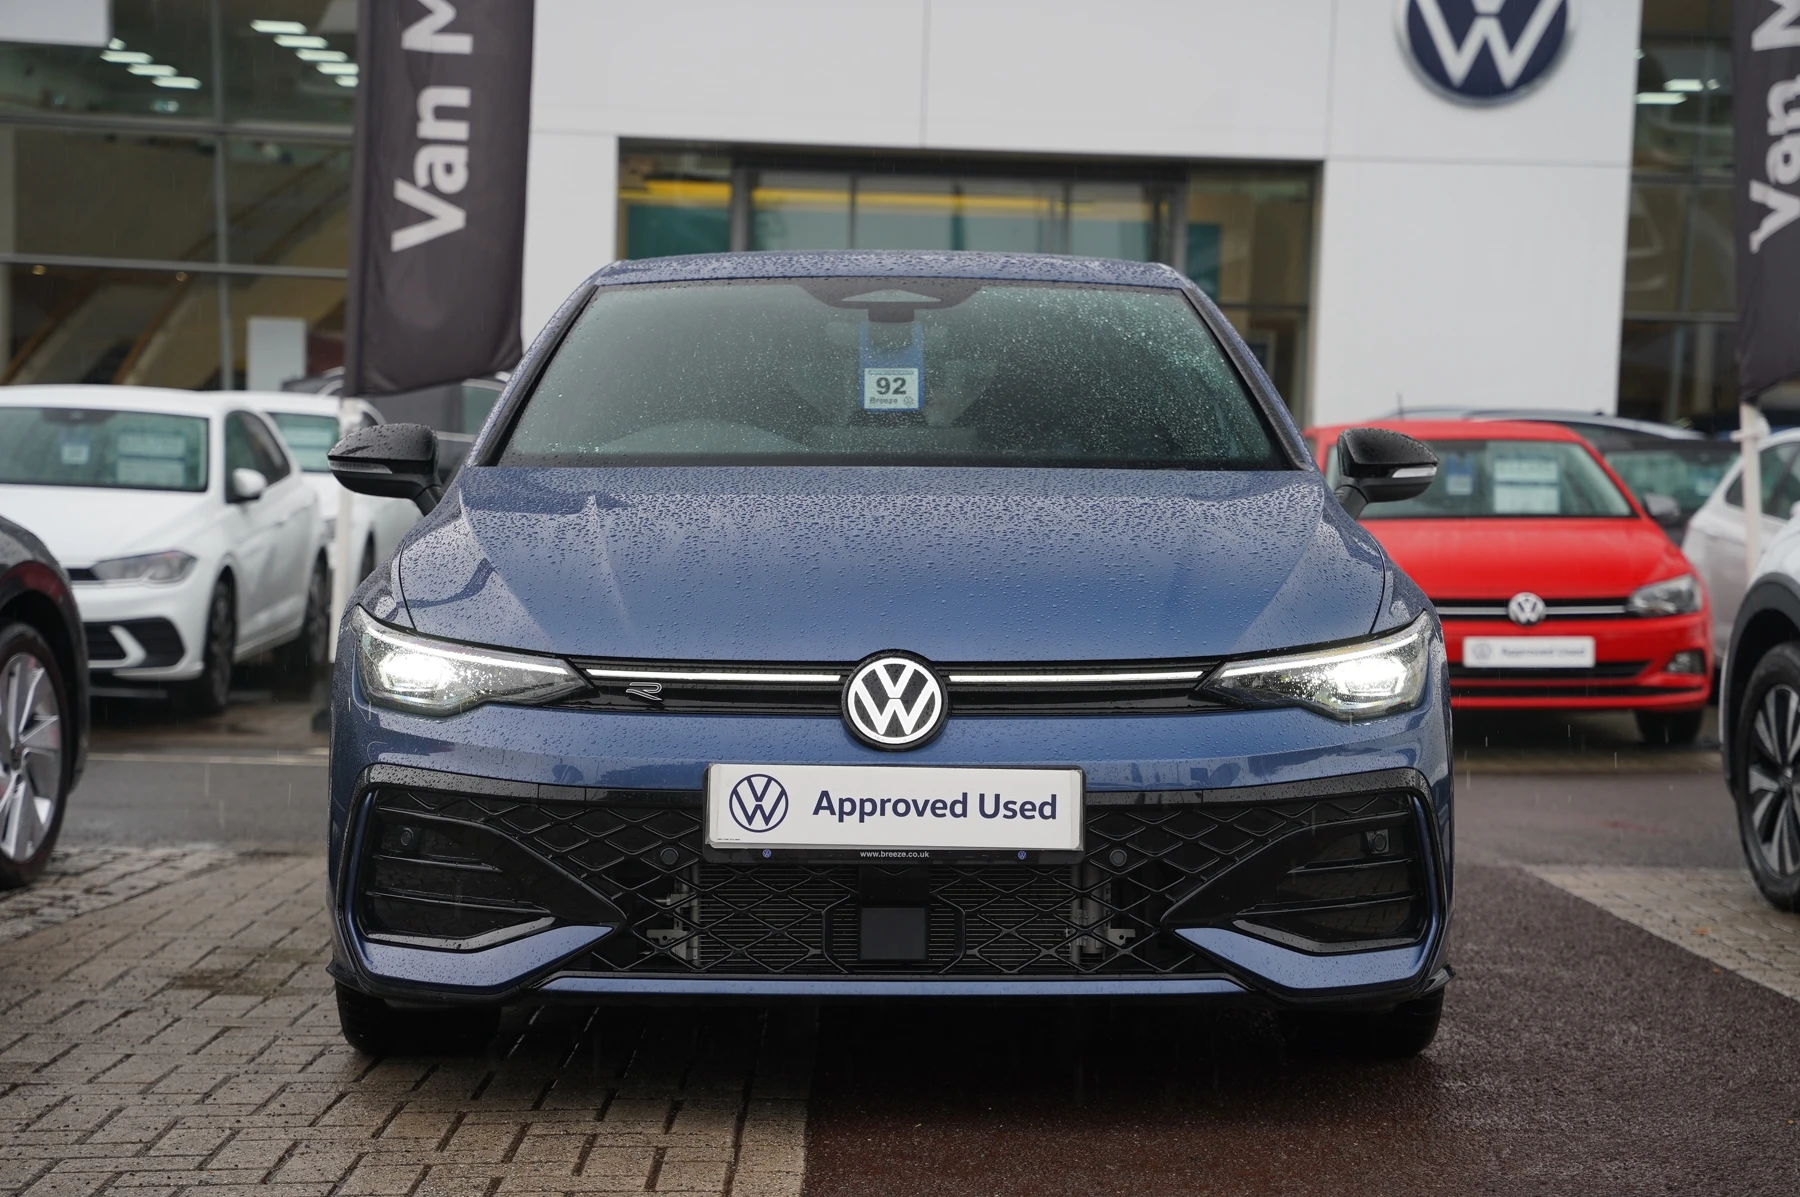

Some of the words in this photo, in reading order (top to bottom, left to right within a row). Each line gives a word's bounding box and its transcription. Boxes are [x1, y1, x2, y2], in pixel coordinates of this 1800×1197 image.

[392, 85, 473, 252] Van
[876, 377, 906, 395] 92
[850, 659, 939, 741] VW
[729, 774, 788, 832] VW
[812, 790, 968, 823] Approved
[979, 793, 1057, 820] Used
